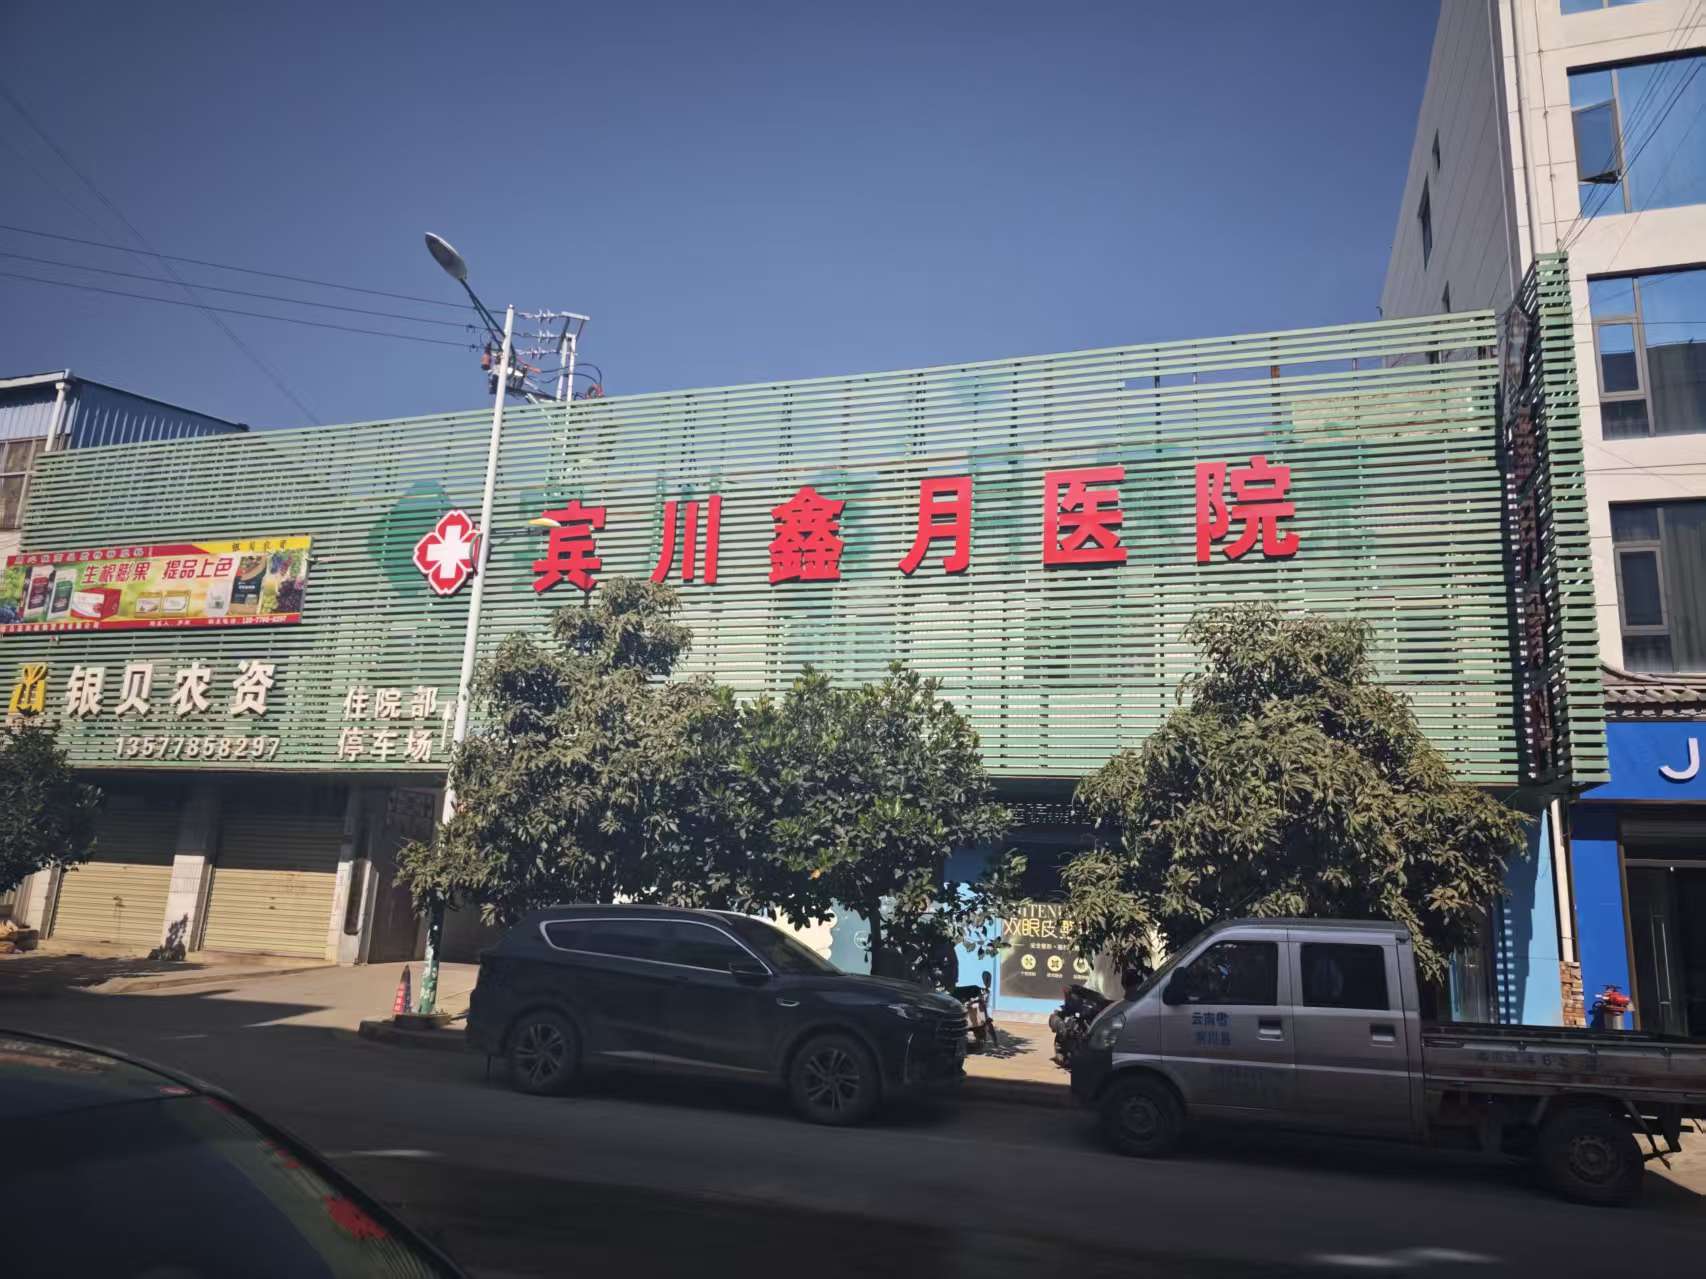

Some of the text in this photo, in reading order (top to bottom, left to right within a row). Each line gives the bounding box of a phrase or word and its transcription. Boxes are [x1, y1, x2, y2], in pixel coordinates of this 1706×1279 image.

[532, 455, 1301, 594] 宾川鑫月医院
[162, 557, 232, 580] 提品上色
[66, 660, 276, 718] 银贝农资
[343, 686, 439, 721] 住院部
[115, 736, 281, 760] 13577858297
[337, 727, 434, 763] 停车场
